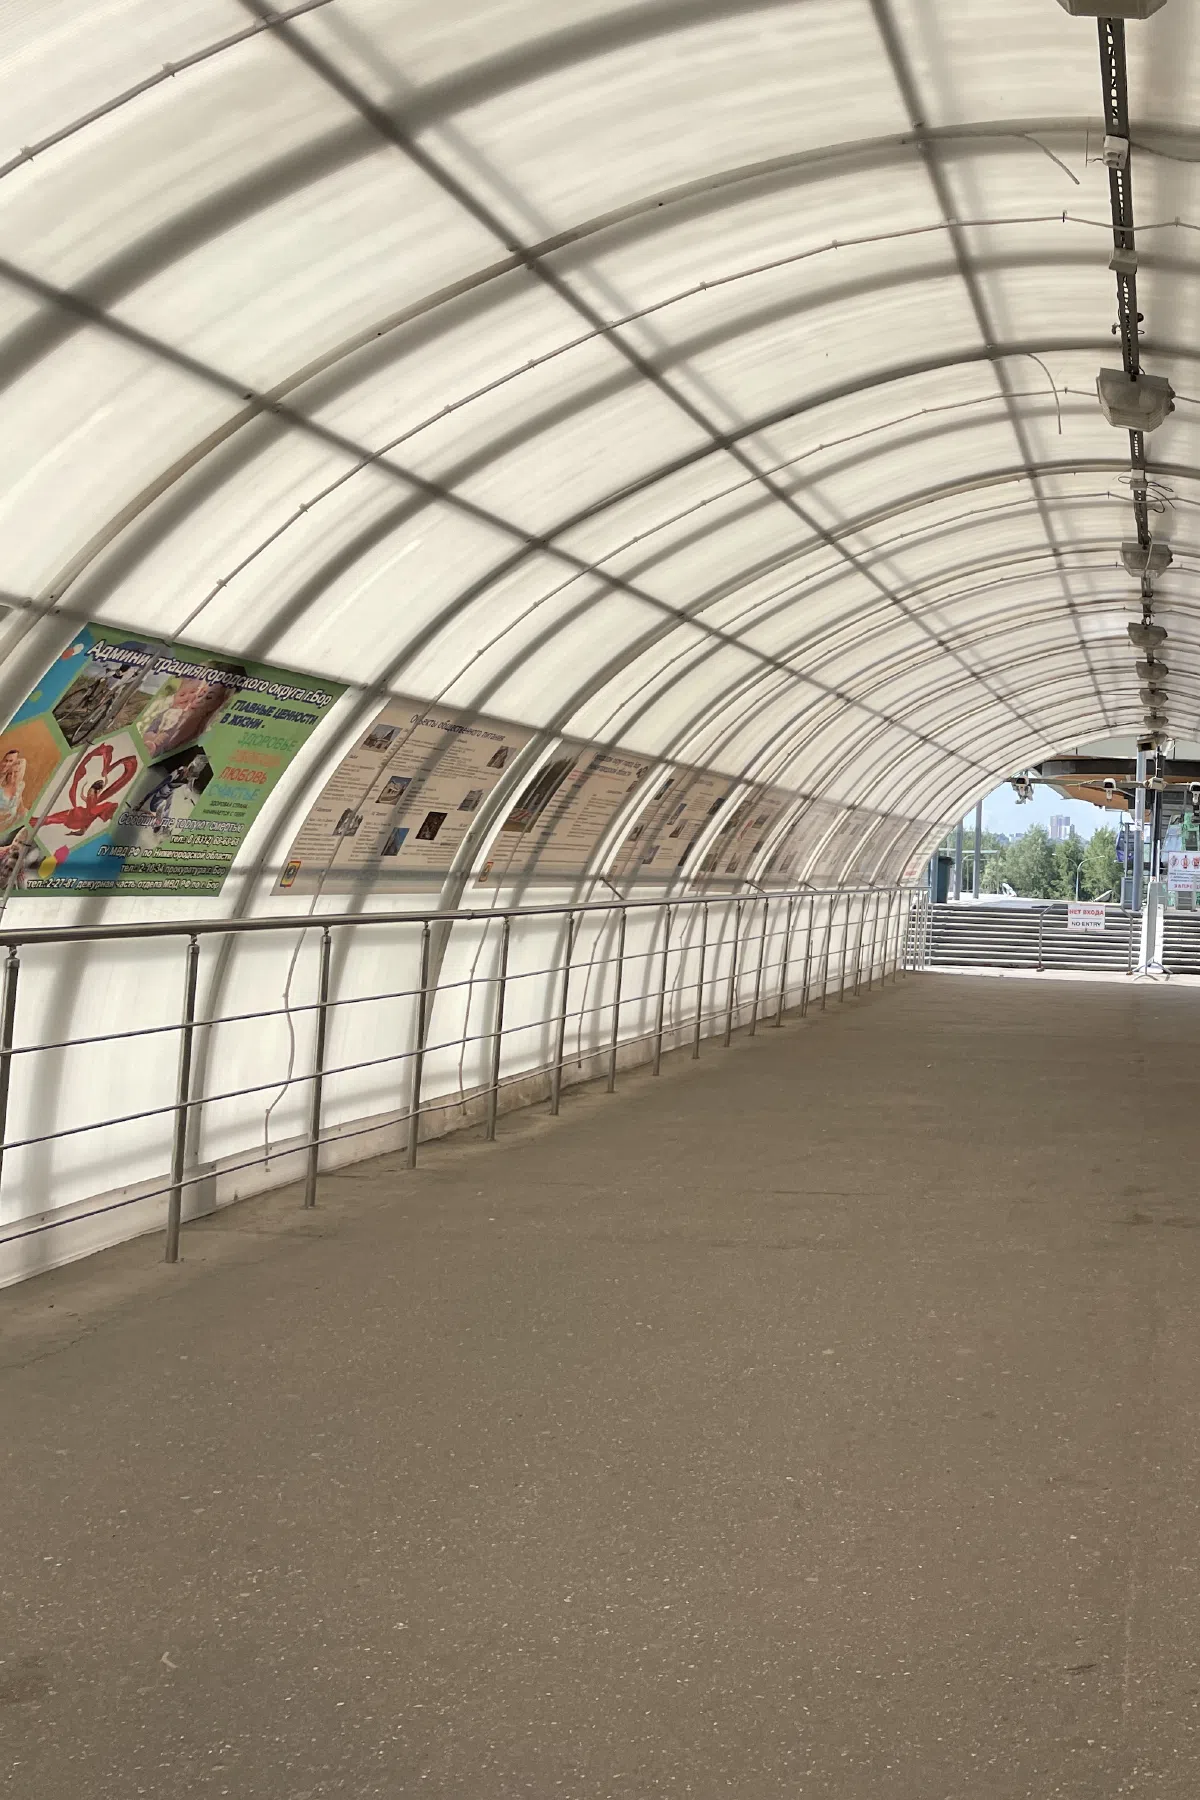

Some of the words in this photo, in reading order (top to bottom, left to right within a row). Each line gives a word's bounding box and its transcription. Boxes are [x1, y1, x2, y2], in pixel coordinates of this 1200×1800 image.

[85, 639, 203, 679] Админитрация
[202, 667, 270, 691] городского
[268, 682, 306, 700] округа
[220, 713, 230, 724] В
[231, 700, 276, 717] ГЛАВНЫЕ
[273, 707, 319, 725] ЦЕННОСТИ
[238, 732, 298, 751] ЗДОРОВЬЕ
[219, 767, 267, 784] ЛЮБОВЬ
[110, 847, 128, 857] МВД
[128, 847, 141, 856] РФ
[142, 849, 153, 857] по
[212, 866, 226, 877] Бор
[115, 880, 136, 888] часть
[137, 880, 163, 890] отдела
[163, 879, 180, 889] МВД
[180, 880, 191, 889] РФ
[206, 880, 220, 891] Бор
